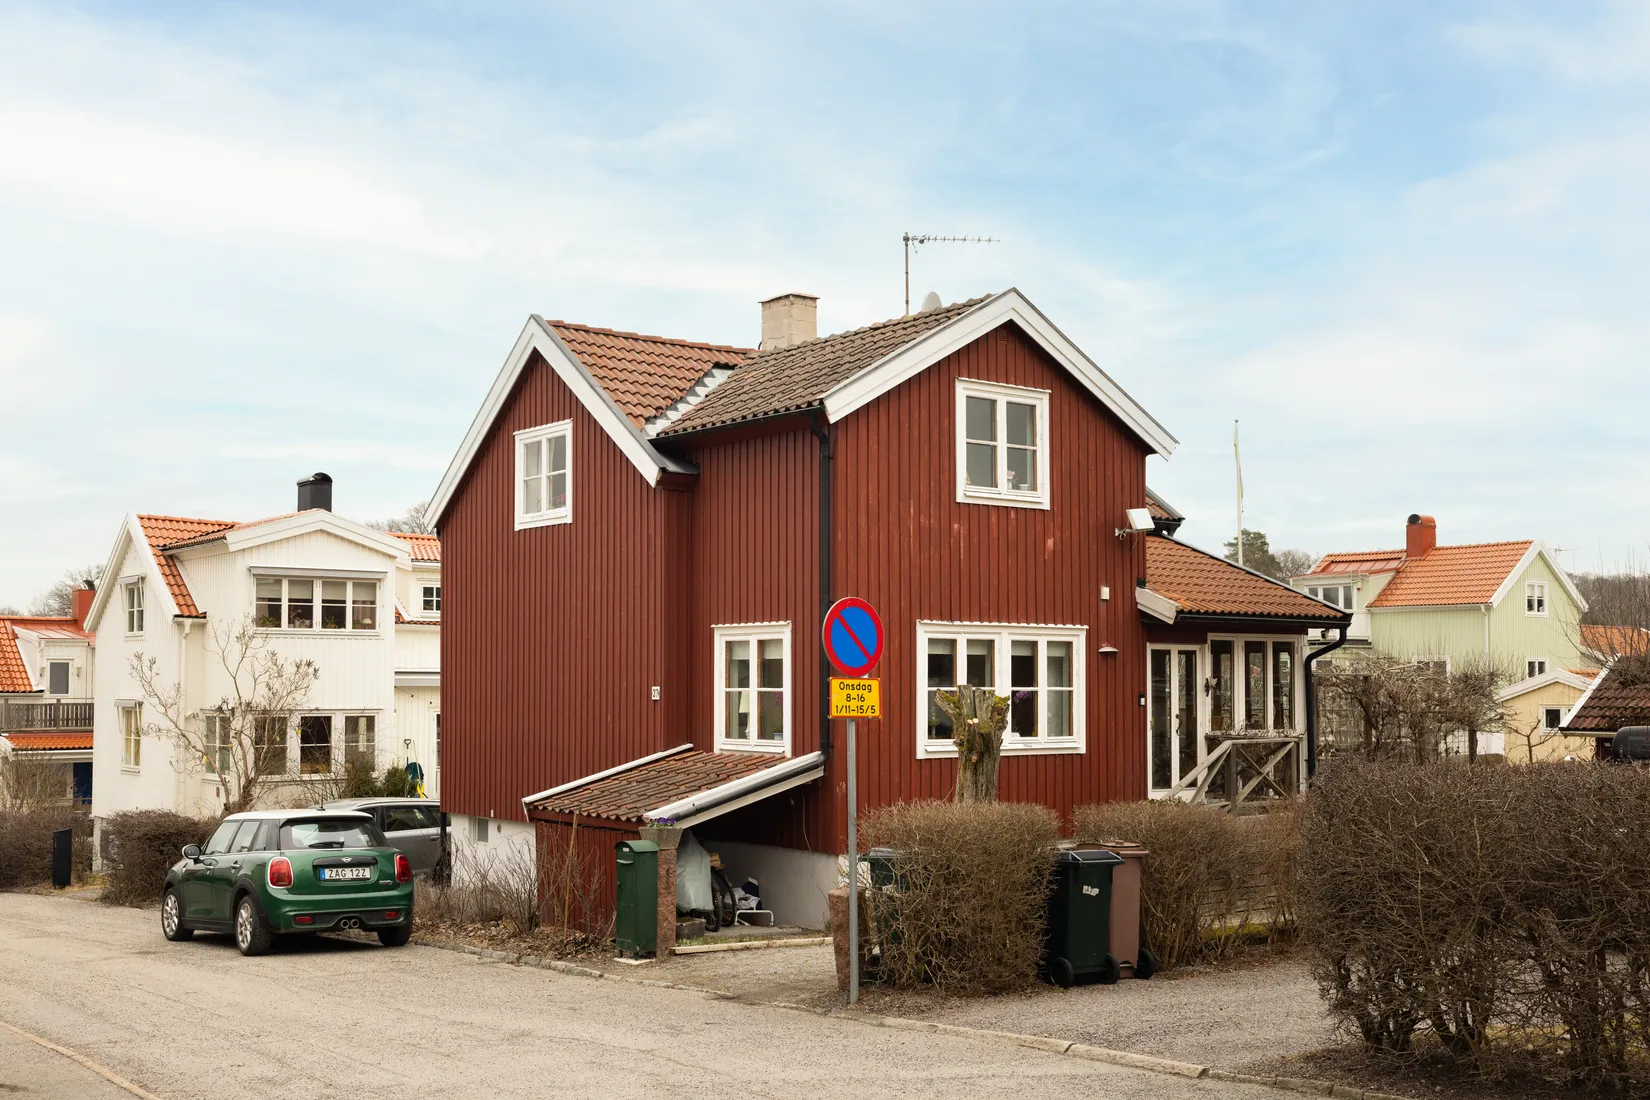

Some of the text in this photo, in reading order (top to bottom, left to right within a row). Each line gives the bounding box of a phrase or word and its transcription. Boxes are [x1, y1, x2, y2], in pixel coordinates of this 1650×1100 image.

[839, 682, 872, 693] Onsdag
[846, 693, 865, 702] 8-16
[836, 705, 876, 714] 1/11-15/5
[328, 868, 367, 878] ZAG 12Z
